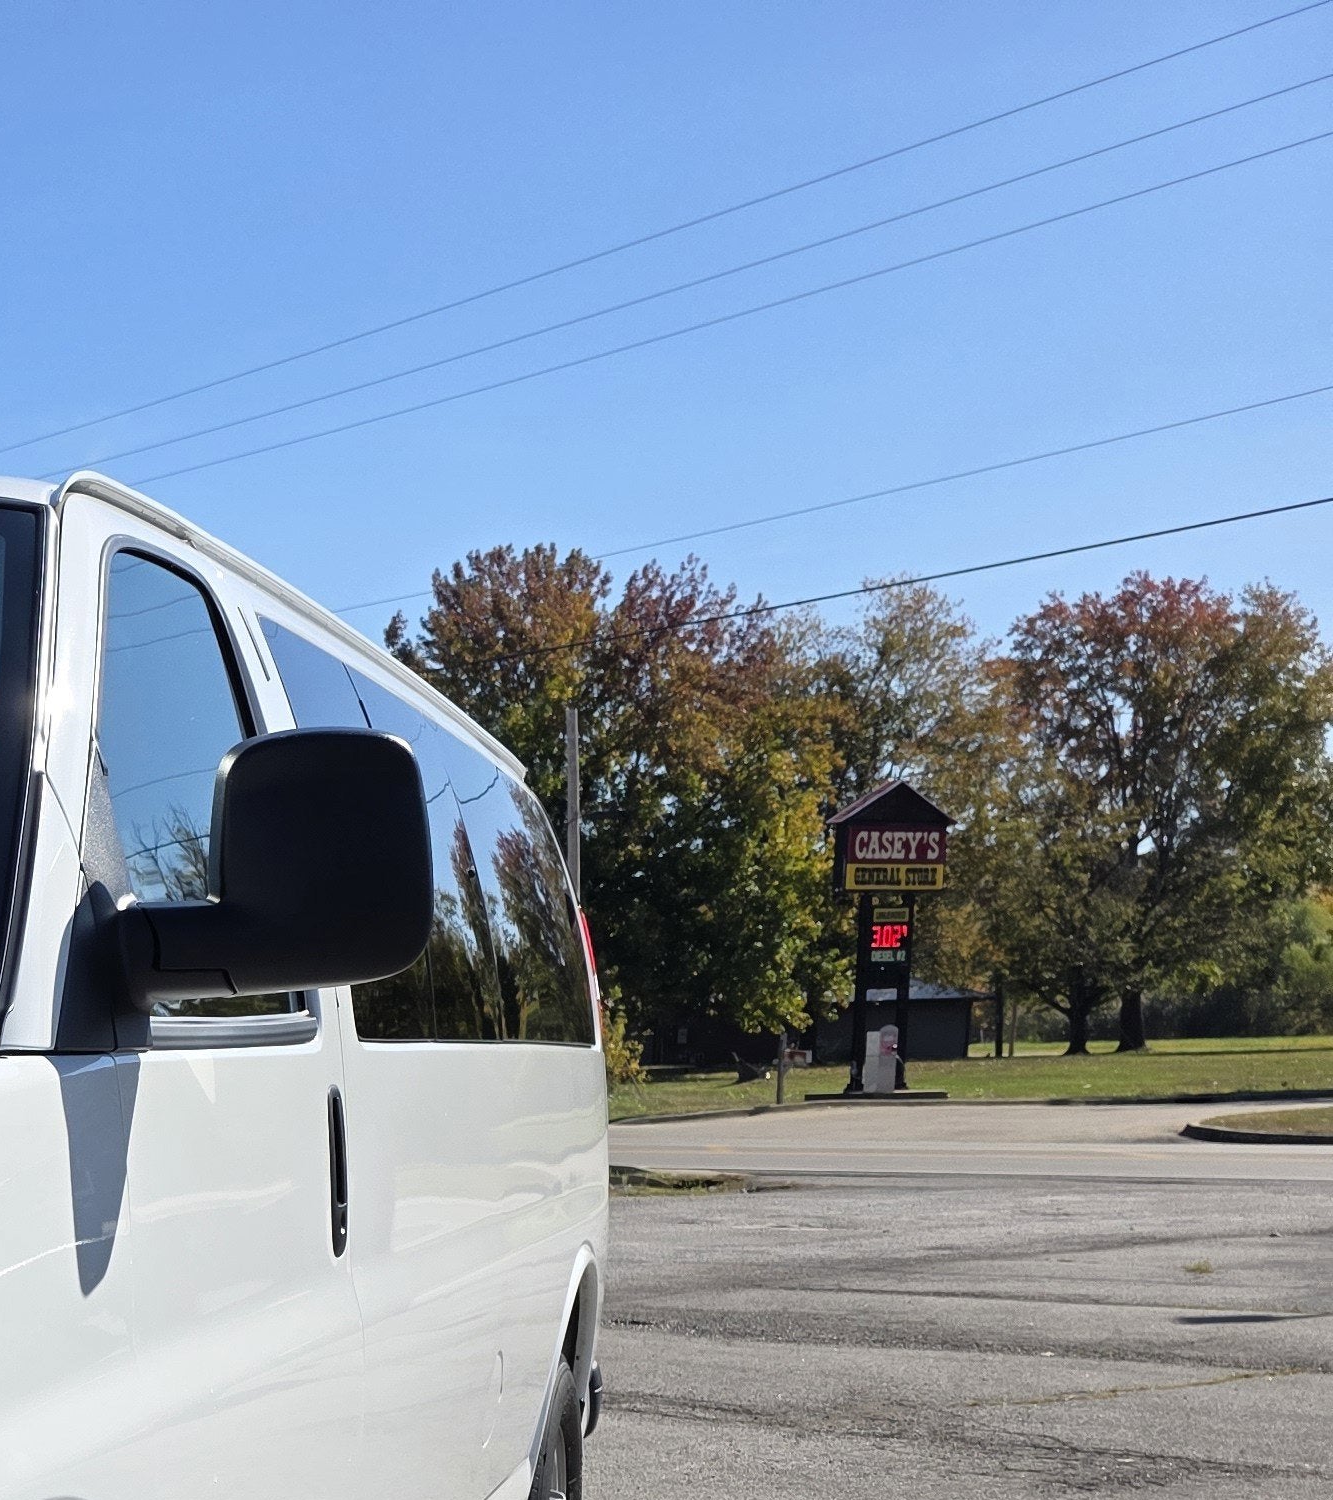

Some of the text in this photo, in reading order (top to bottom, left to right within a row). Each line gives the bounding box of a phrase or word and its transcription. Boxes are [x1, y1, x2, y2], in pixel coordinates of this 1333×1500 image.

[855, 830, 940, 860] CASEY'S
[854, 867, 938, 886] GENERAL STORE
